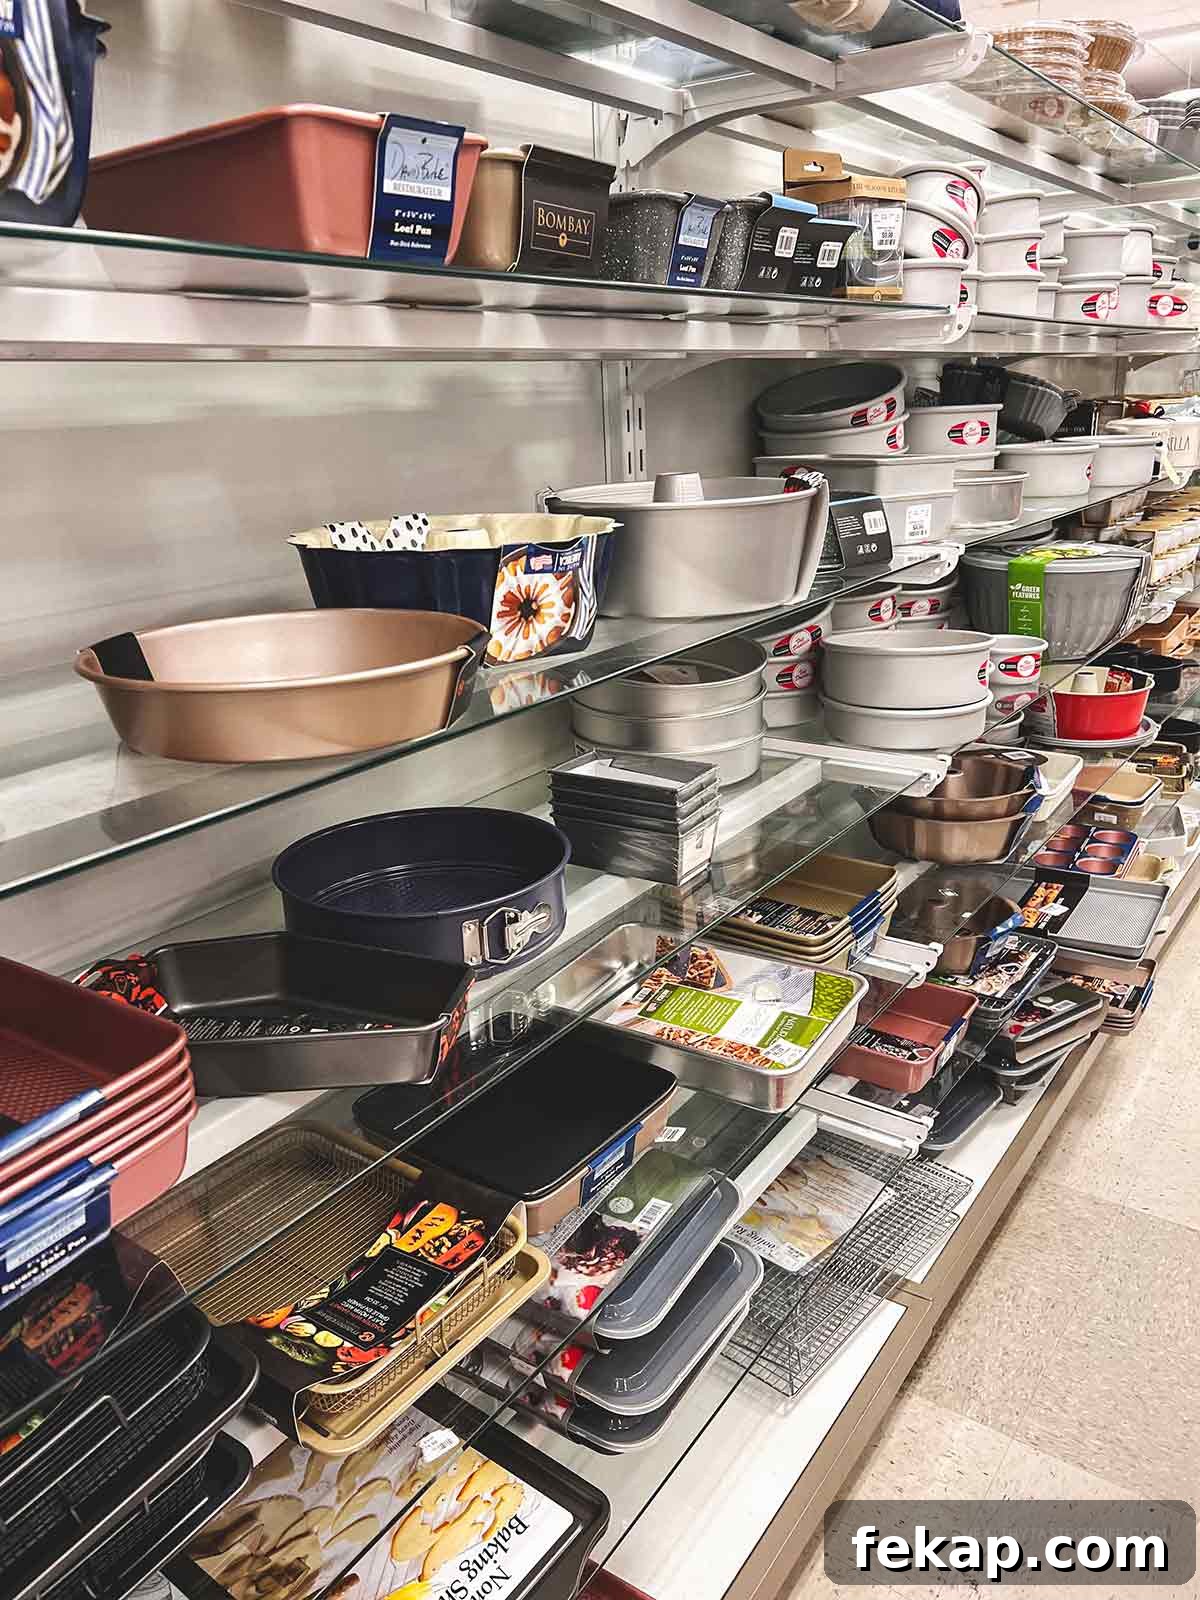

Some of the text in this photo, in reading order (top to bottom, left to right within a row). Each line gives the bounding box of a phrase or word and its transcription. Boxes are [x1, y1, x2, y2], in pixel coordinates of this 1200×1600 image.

[394, 222, 433, 236] Loaf Pan
[536, 207, 591, 237] BOMBAY
[1012, 591, 1041, 600] FEATURES
[1, 1266, 39, 1294] Square
[41, 1249, 66, 1269] Bake
[67, 1236, 87, 1251] Pan
[459, 1514, 530, 1582] Baking
